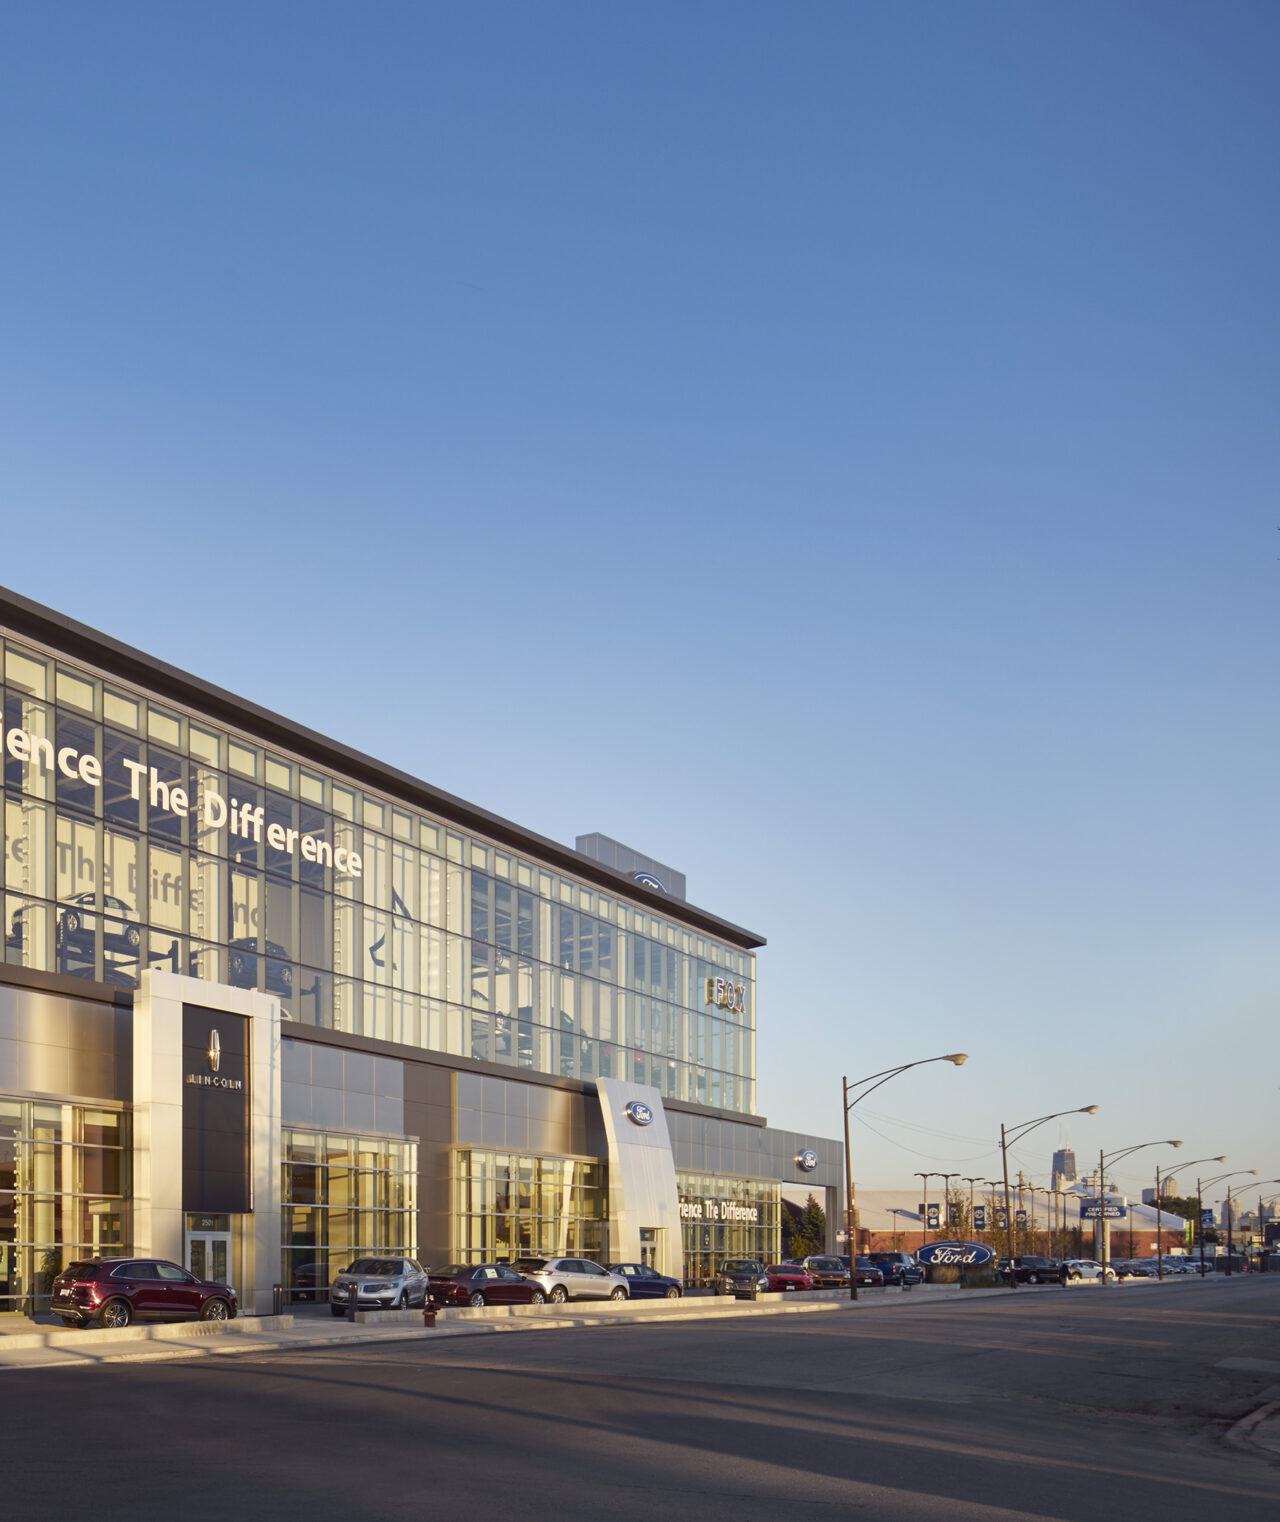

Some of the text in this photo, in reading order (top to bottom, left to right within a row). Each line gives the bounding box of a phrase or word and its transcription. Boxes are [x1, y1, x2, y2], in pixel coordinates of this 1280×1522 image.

[123, 758, 189, 817] The
[203, 789, 363, 877] Difference
[714, 976, 747, 1013] FOX
[190, 1074, 242, 1089] LINCOLN
[705, 1200, 718, 1219] The
[721, 1201, 757, 1221] Difference
[930, 1246, 977, 1264] Ford
